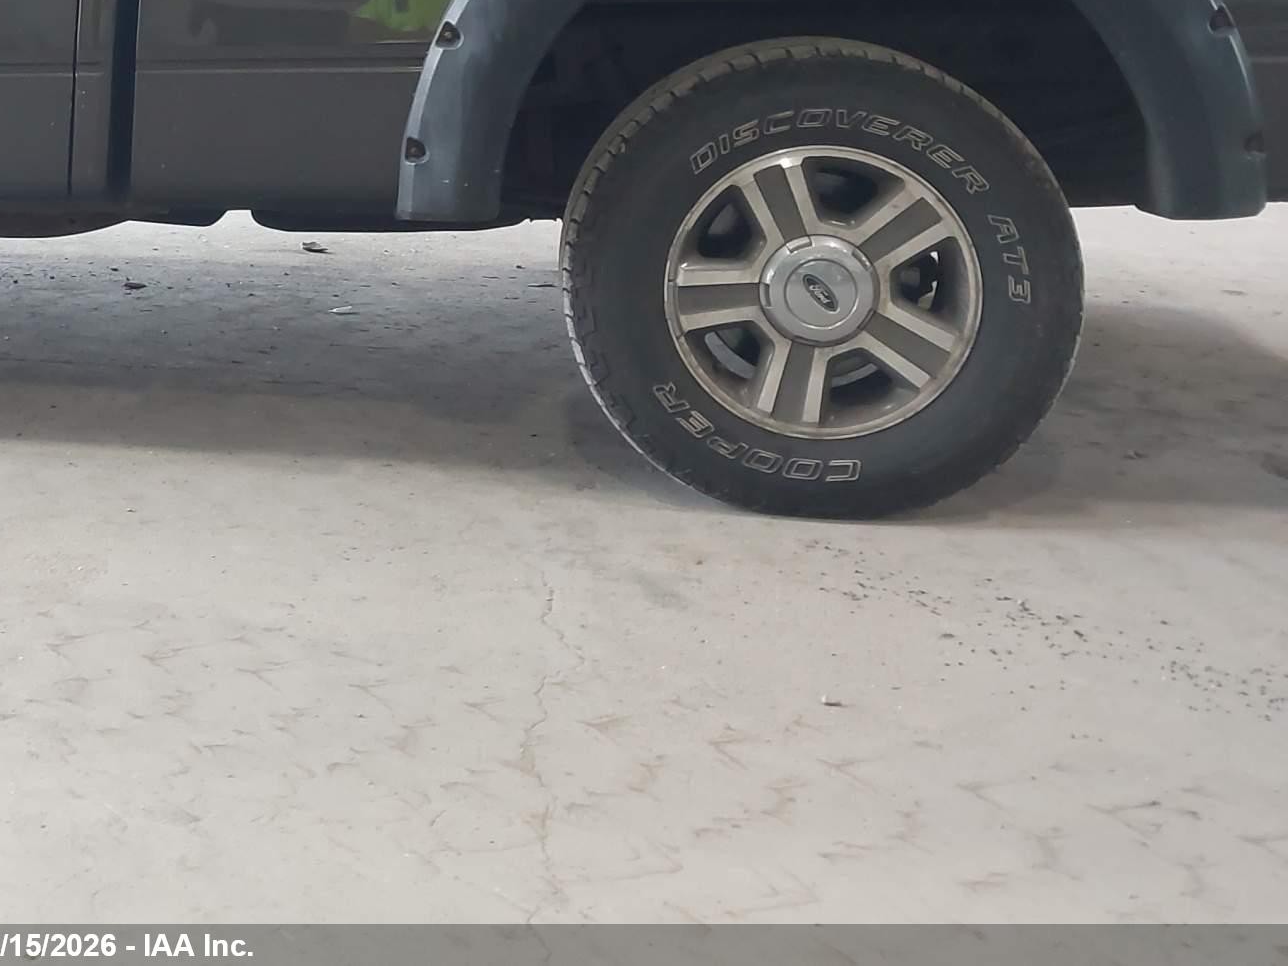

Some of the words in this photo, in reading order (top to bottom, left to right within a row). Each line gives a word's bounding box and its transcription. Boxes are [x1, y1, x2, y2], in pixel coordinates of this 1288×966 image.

[689, 109, 990, 194] DISCOVERER
[987, 213, 1031, 305] AT3
[652, 382, 862, 482] COOPER
